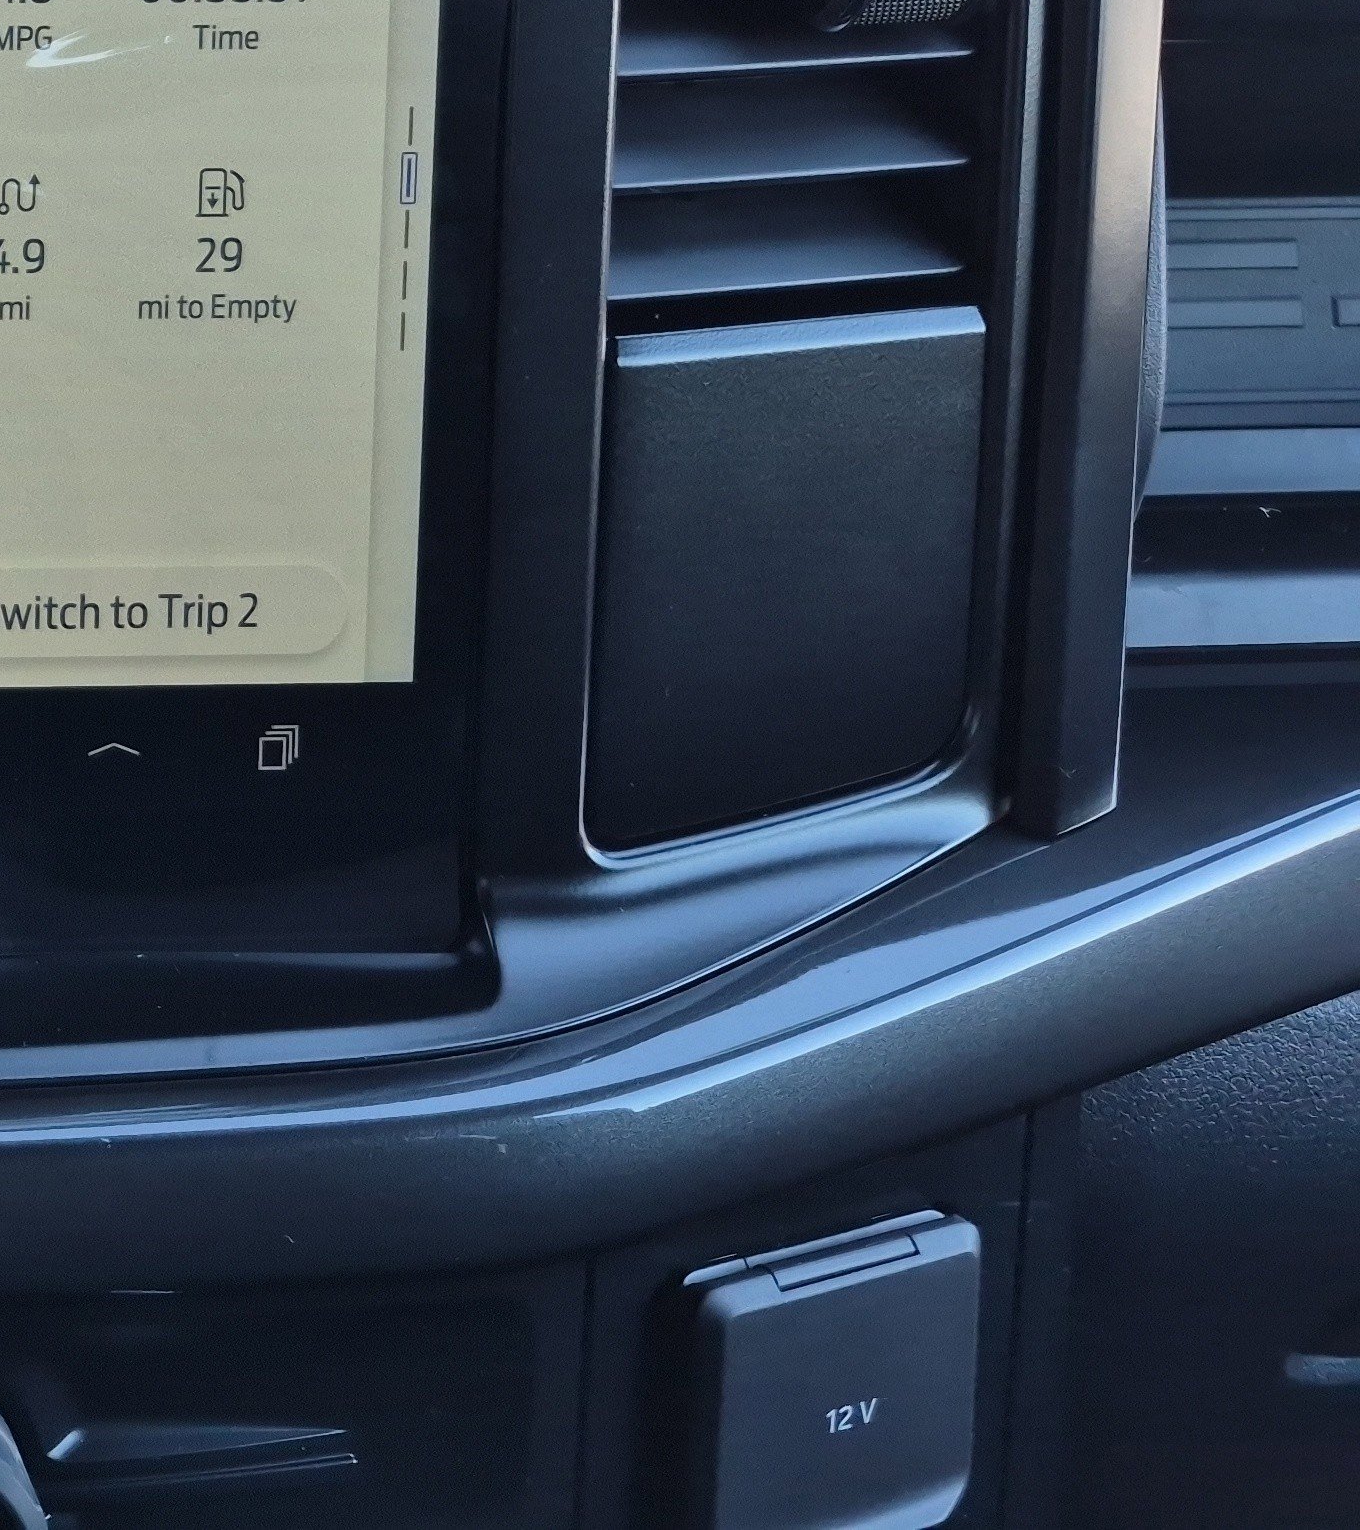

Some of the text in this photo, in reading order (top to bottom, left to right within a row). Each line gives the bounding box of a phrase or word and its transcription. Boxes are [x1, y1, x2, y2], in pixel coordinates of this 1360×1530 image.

[193, 24, 259, 50] Time
[195, 237, 244, 273] 29
[137, 294, 298, 324] mi to Empty
[110, 596, 149, 630] to
[158, 592, 229, 635] Trip
[238, 592, 260, 629] 2
